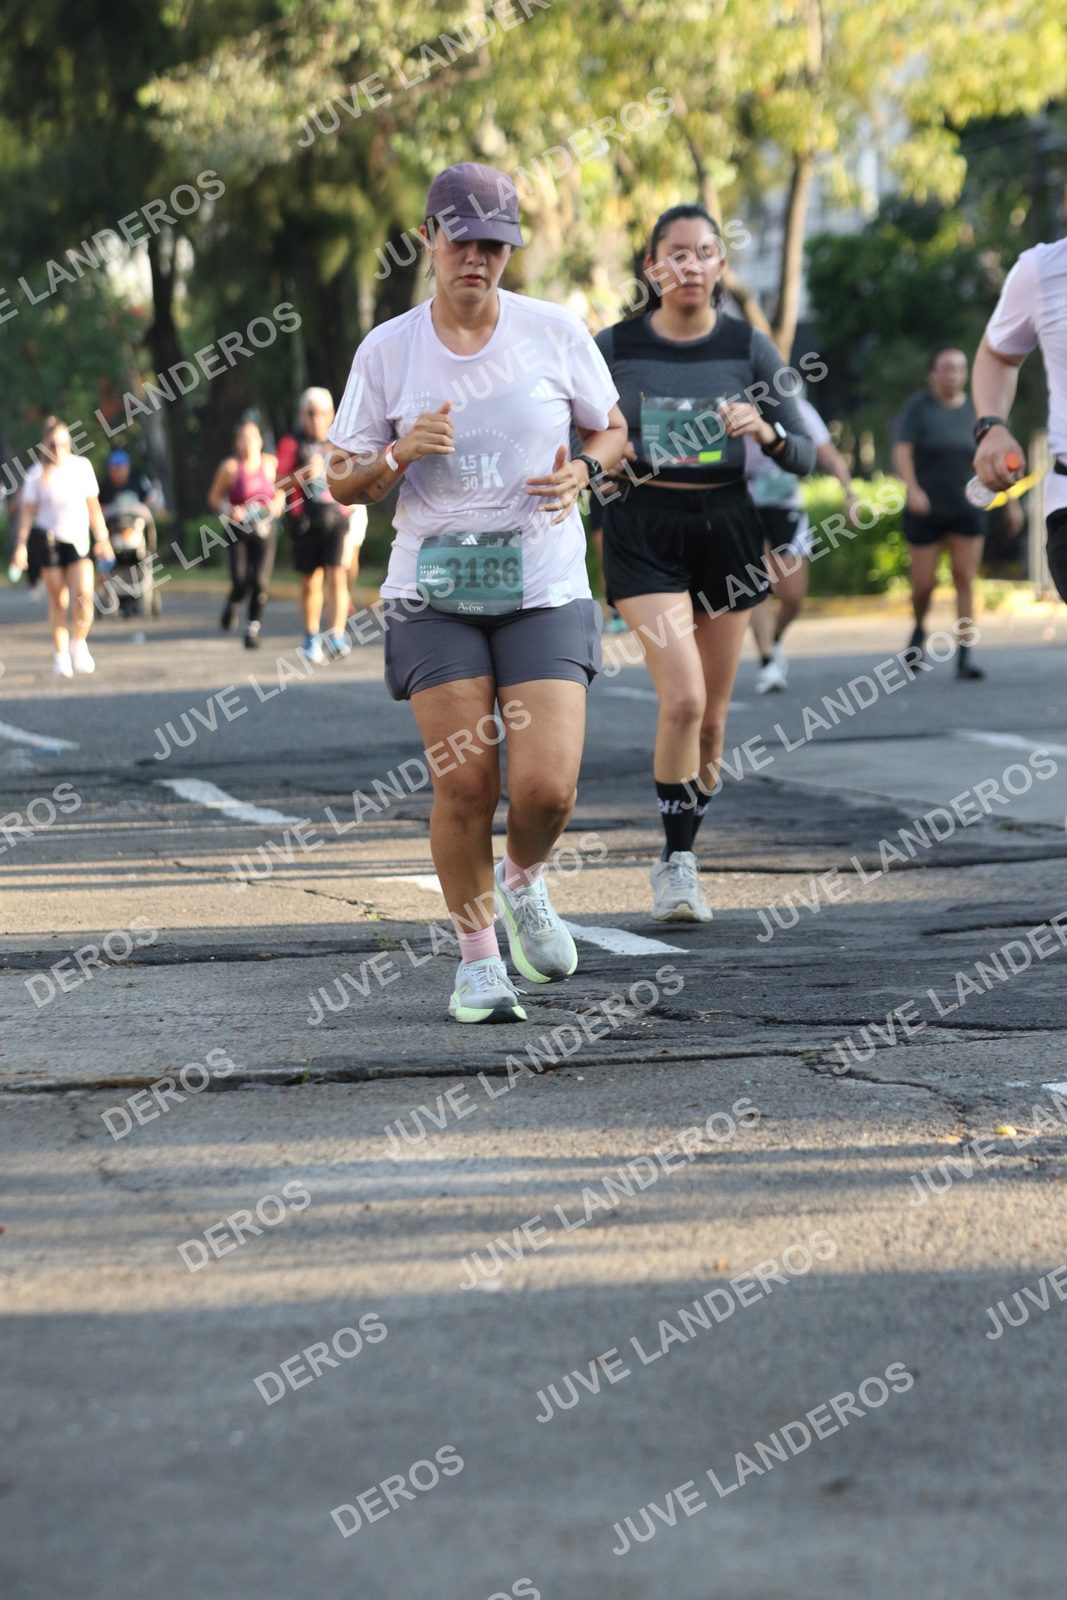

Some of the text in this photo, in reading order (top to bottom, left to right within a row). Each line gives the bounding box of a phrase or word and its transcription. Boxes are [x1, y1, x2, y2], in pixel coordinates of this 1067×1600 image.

[458, 454, 477, 471] 15
[480, 452, 504, 489] K
[462, 476, 479, 491] 30
[446, 557, 519, 589] 3186
